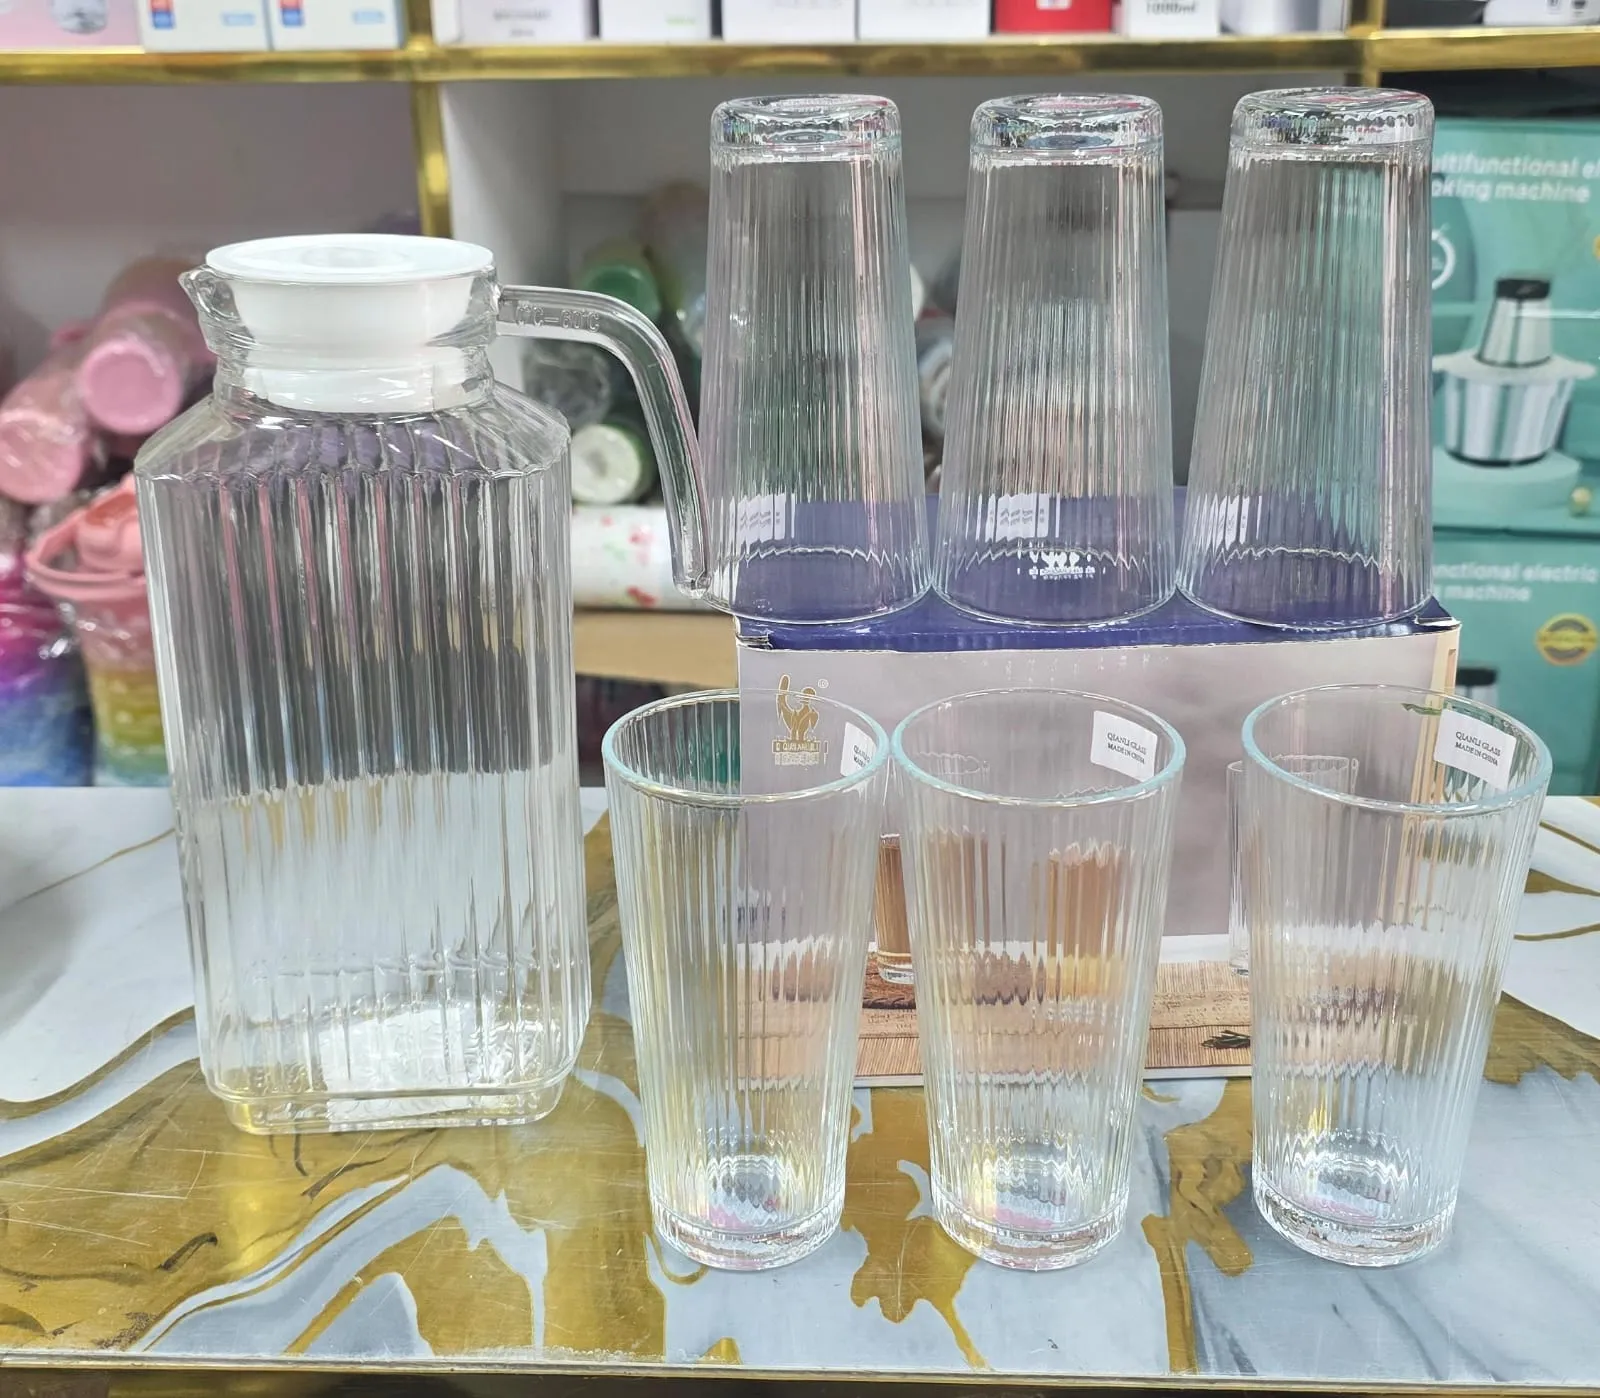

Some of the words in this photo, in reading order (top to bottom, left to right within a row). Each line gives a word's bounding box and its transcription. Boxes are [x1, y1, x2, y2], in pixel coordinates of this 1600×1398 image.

[1432, 152, 1578, 177] ultifunctional
[1432, 177, 1491, 203] oking
[1495, 179, 1590, 203] machine
[1433, 562, 1521, 581] nctional
[1523, 563, 1597, 584] electric
[1444, 584, 1531, 602] machine
[1107, 732, 1130, 747] QIANLI
[1107, 742, 1124, 754] MADE
[1455, 731, 1481, 747] QIANLI
[1482, 742, 1501, 756] GLASS
[1455, 741, 1474, 754] MADE
[1481, 752, 1498, 766] CHINA
